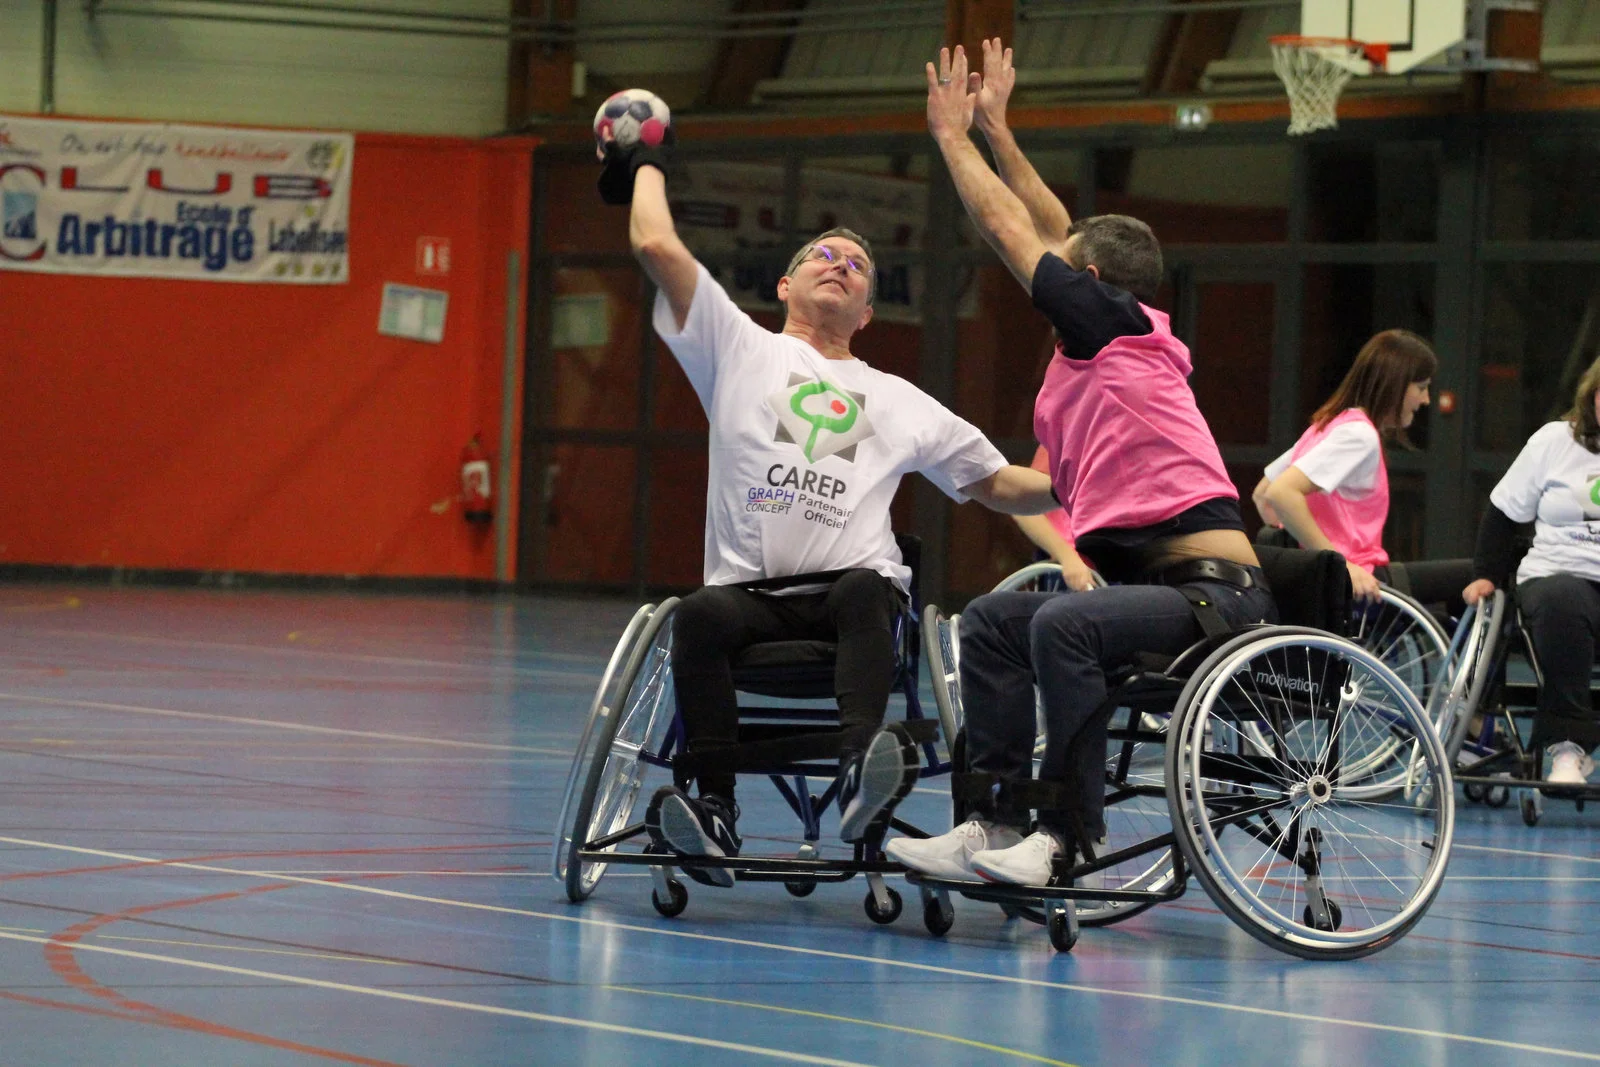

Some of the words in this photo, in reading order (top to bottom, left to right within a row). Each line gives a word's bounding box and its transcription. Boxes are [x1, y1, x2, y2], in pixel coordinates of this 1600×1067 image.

[57, 212, 254, 271] Arbitrage
[767, 463, 846, 500] CAREP
[748, 487, 795, 503] GRAPH
[798, 493, 853, 518] Partenair
[745, 503, 791, 515] CONCEPT
[804, 509, 847, 530] Officiel
[1256, 672, 1319, 694] motivation
